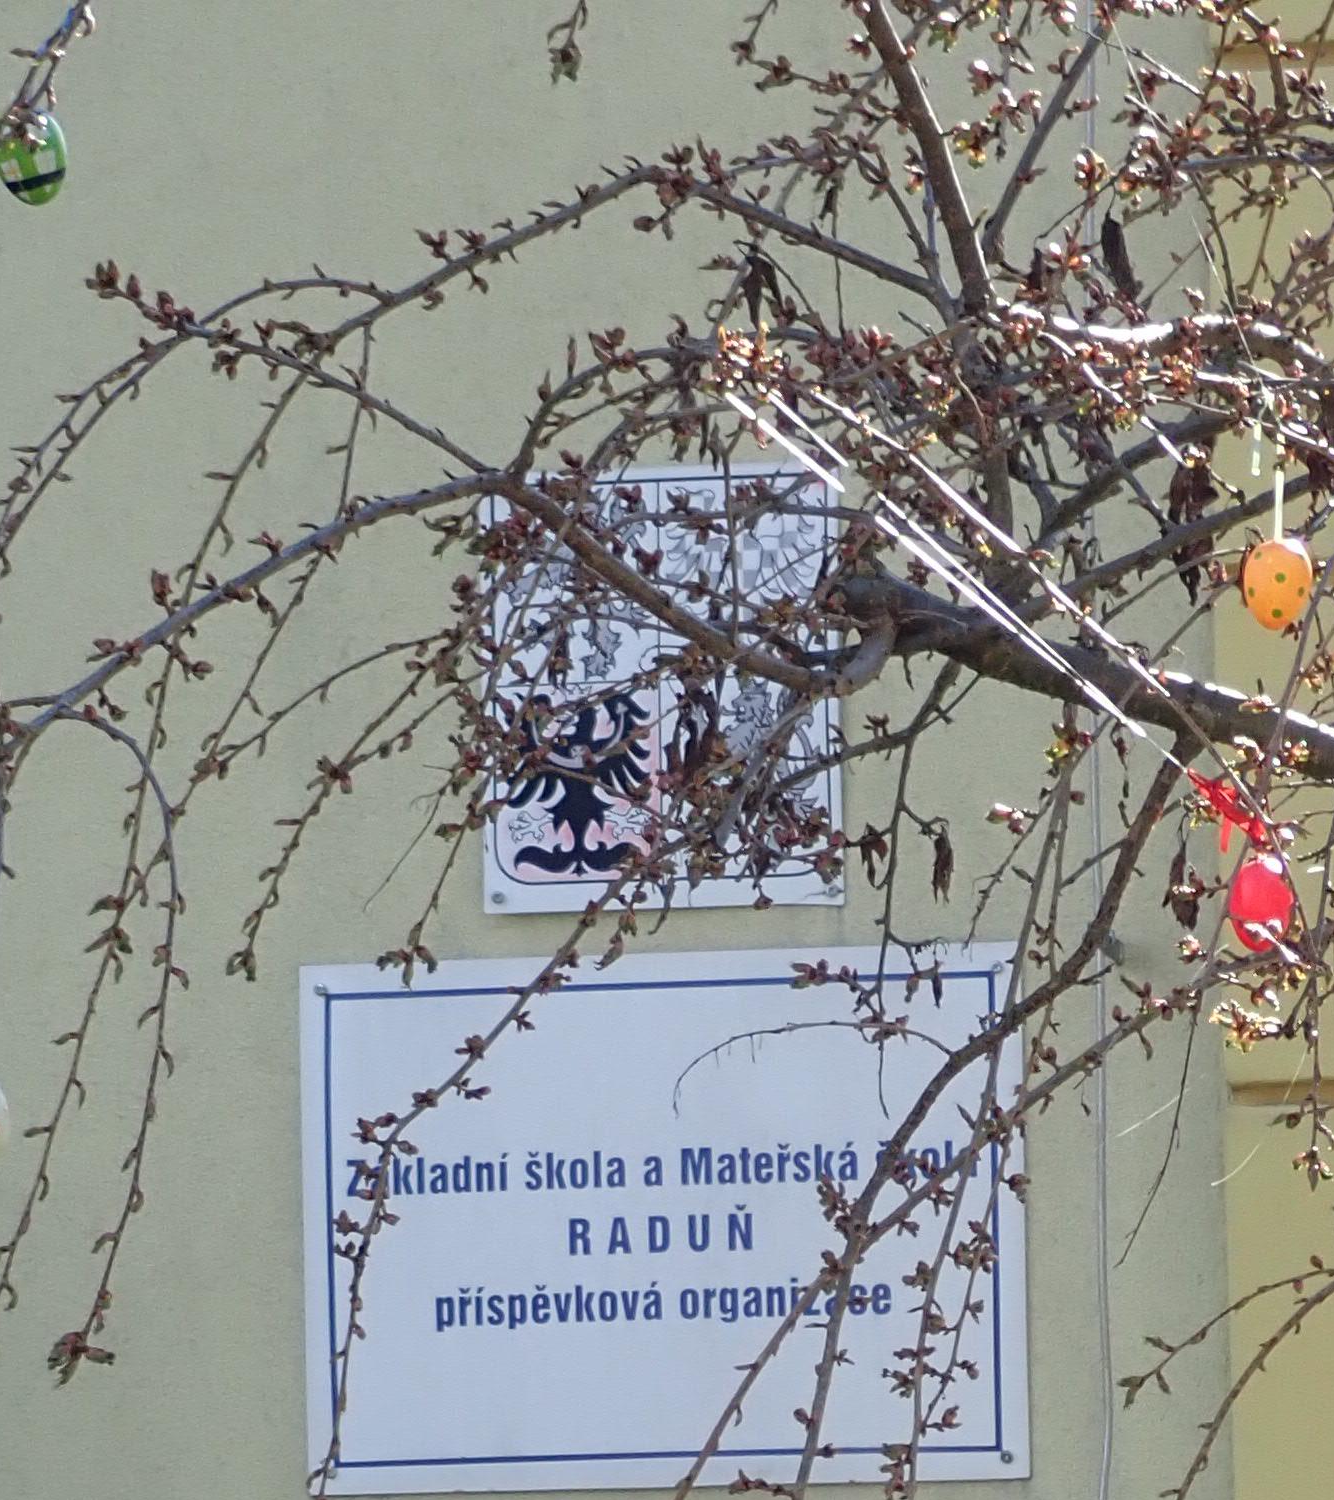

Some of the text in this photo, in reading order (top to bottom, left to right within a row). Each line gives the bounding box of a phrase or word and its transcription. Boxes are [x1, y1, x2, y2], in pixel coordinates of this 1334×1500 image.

[524, 1150, 627, 1190] škola
[642, 1159, 664, 1187] a
[679, 1140, 859, 1187] Mateřská
[568, 1204, 755, 1256] RADUŇ
[435, 1281, 664, 1332] příspěvková
